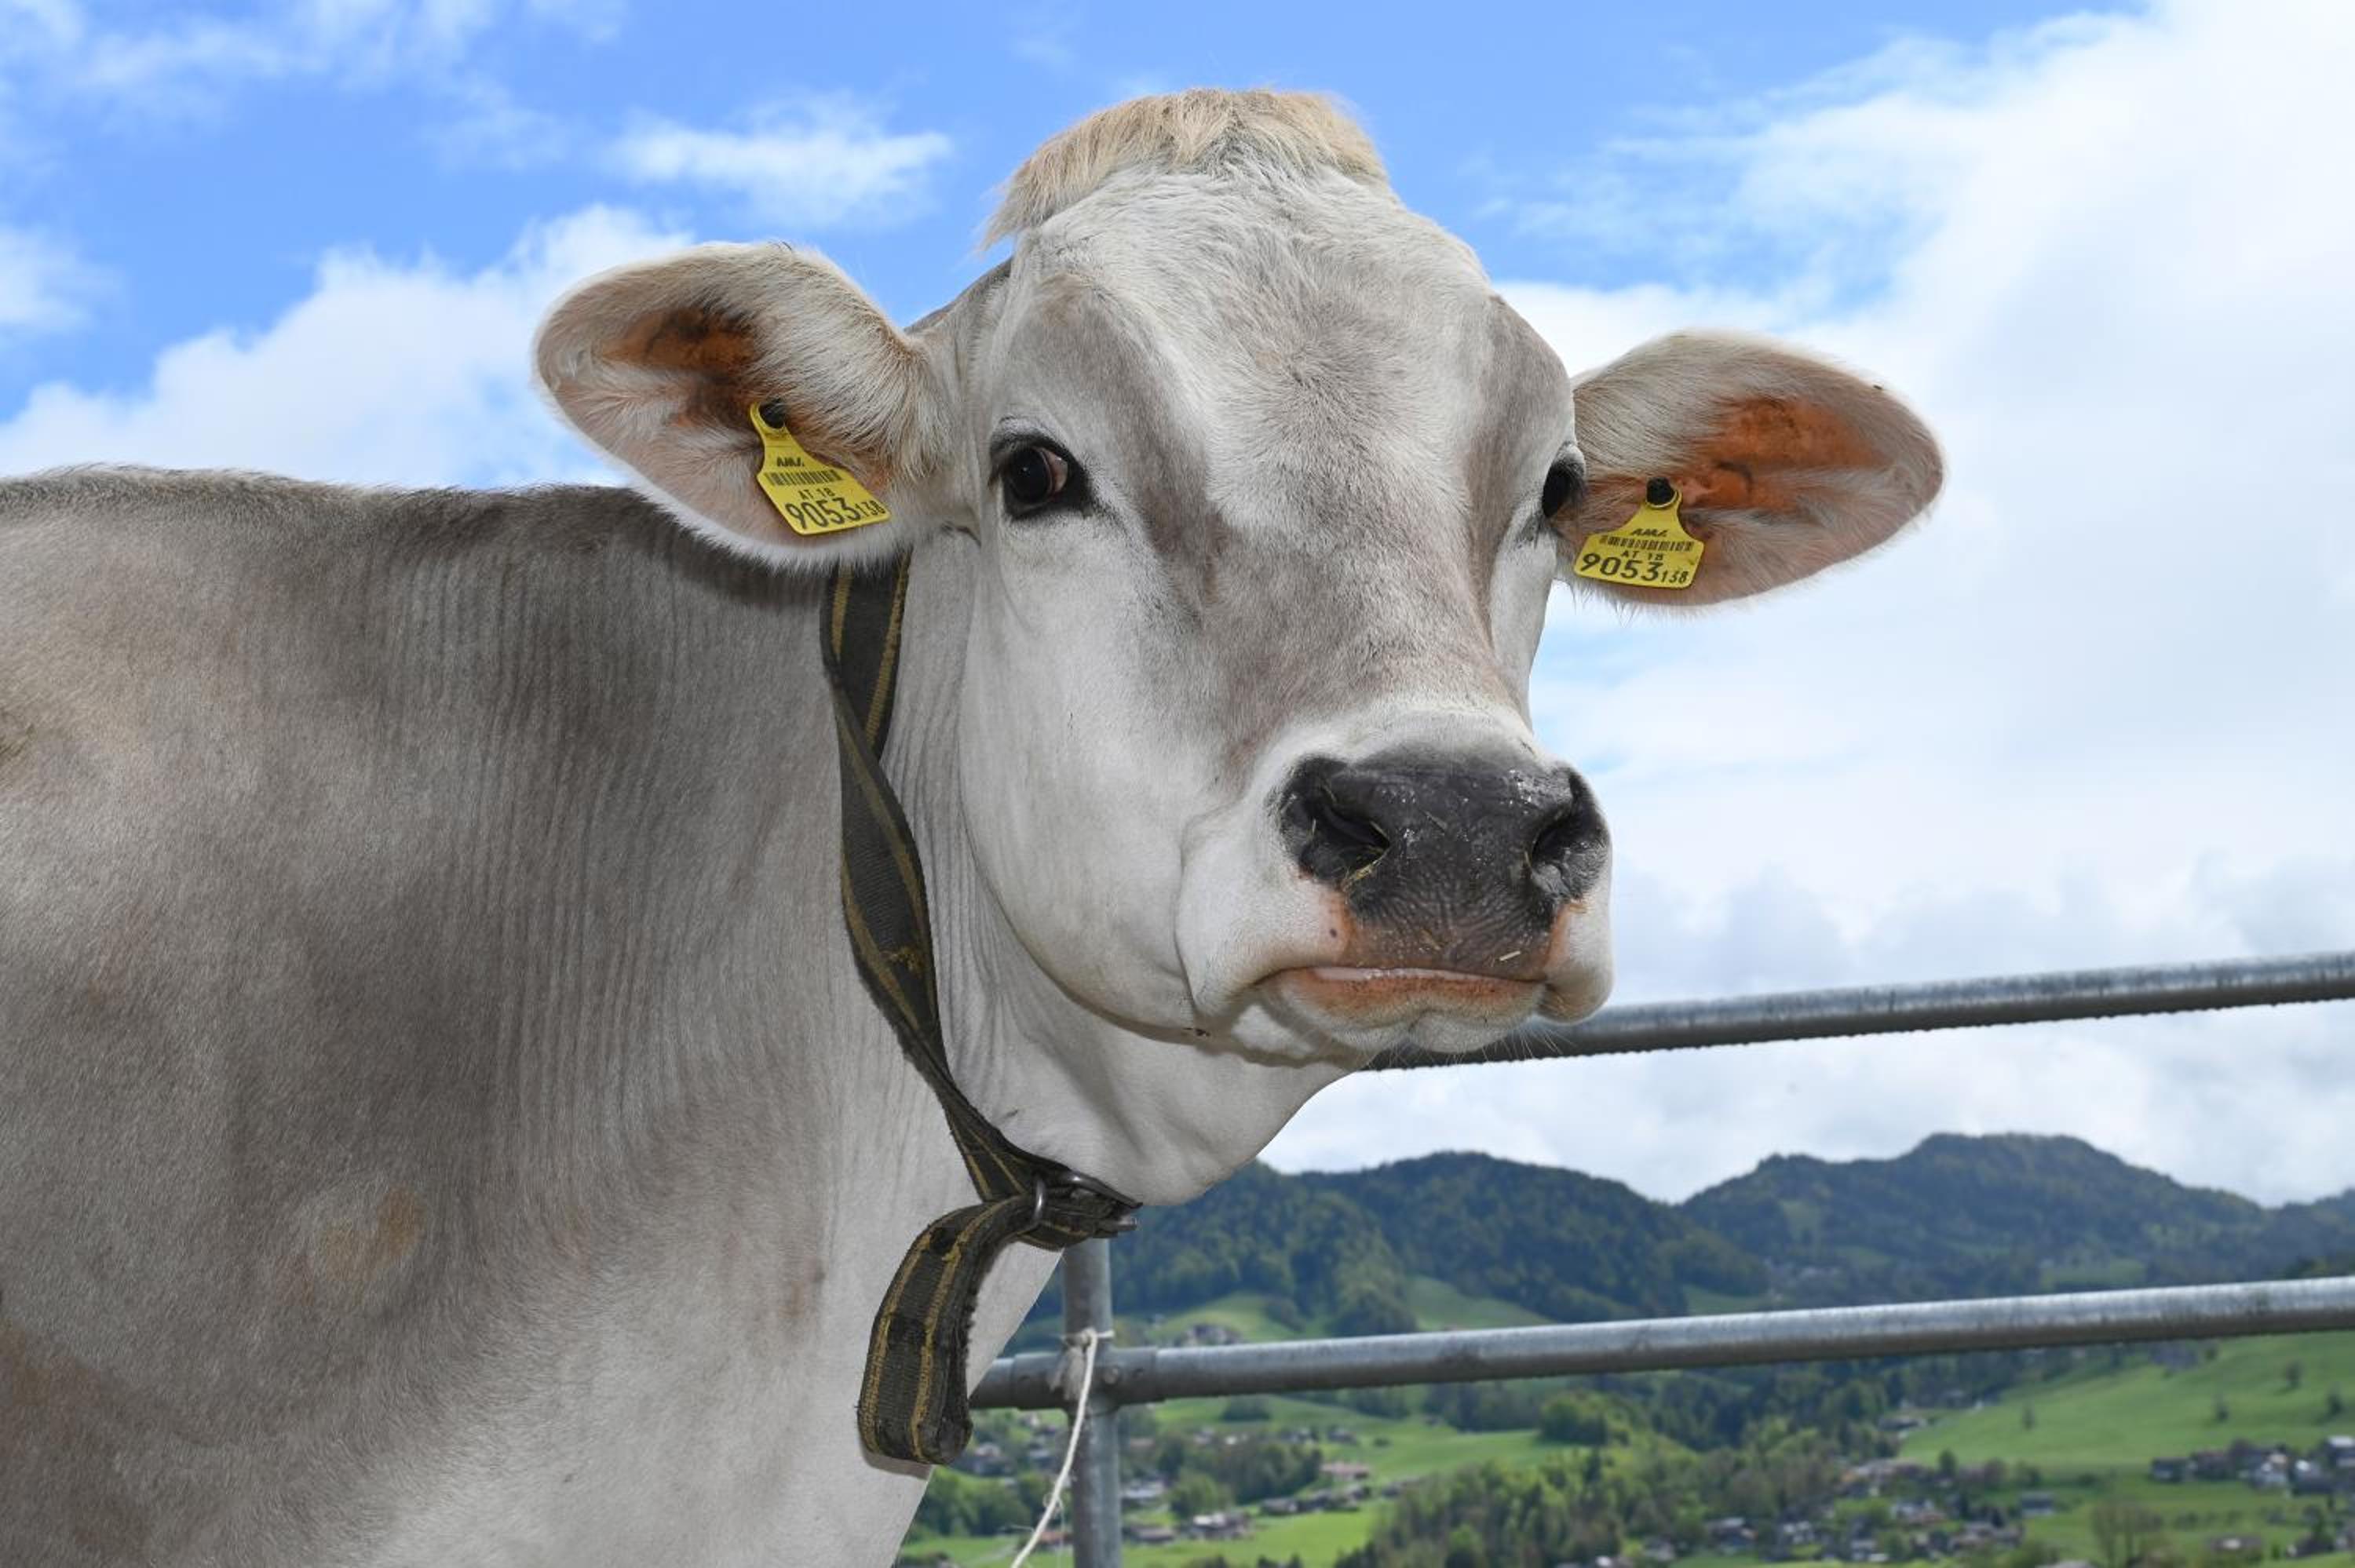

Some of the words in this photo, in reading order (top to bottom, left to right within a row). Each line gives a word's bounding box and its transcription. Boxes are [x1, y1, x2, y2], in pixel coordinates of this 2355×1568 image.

[798, 489, 814, 499] AT
[785, 497, 860, 530] 9053
[1580, 552, 1663, 582] 9053
